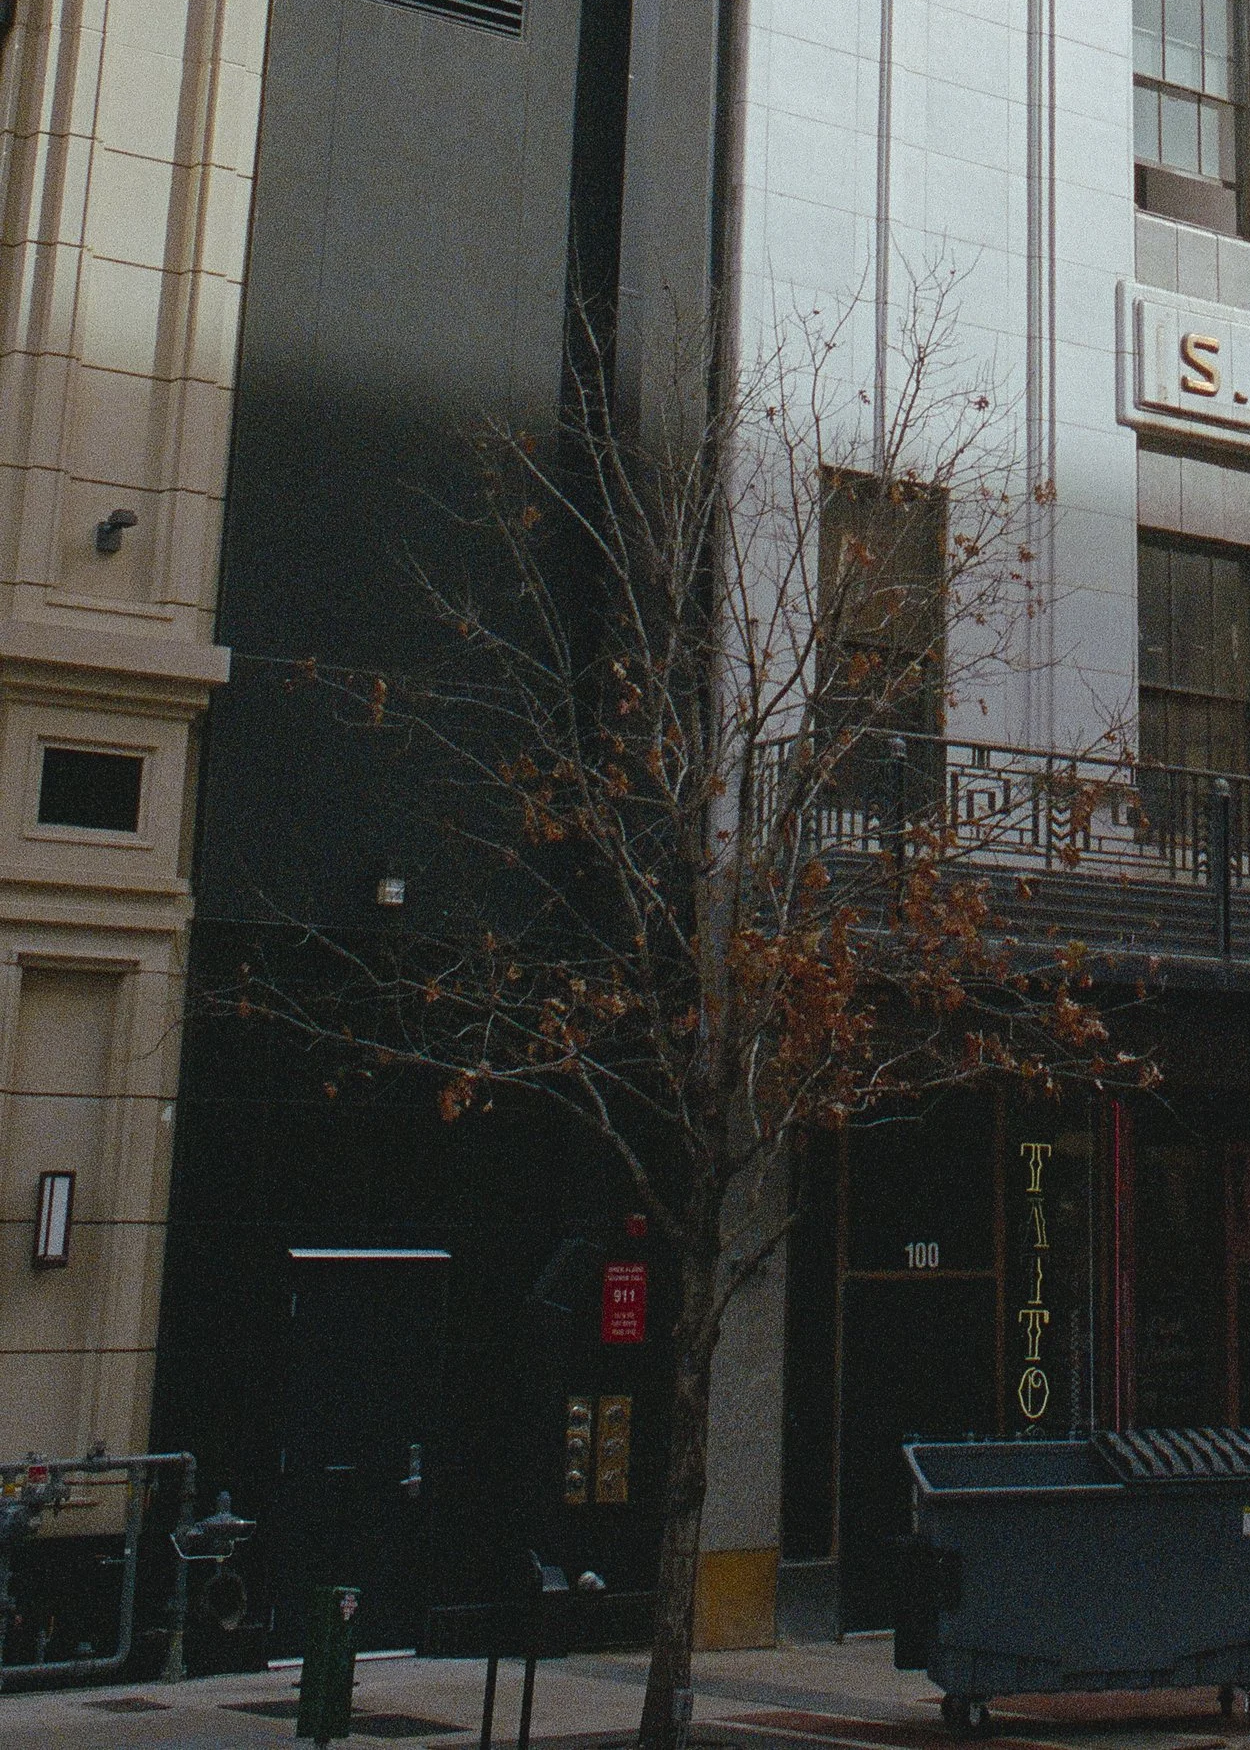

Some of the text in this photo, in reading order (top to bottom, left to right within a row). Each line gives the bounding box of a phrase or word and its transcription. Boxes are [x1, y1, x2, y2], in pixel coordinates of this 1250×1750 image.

[1180, 331, 1249, 405] S.
[905, 1242, 939, 1268] 100
[613, 1289, 635, 1304] 911
[1018, 1143, 1052, 1440] TATTO
